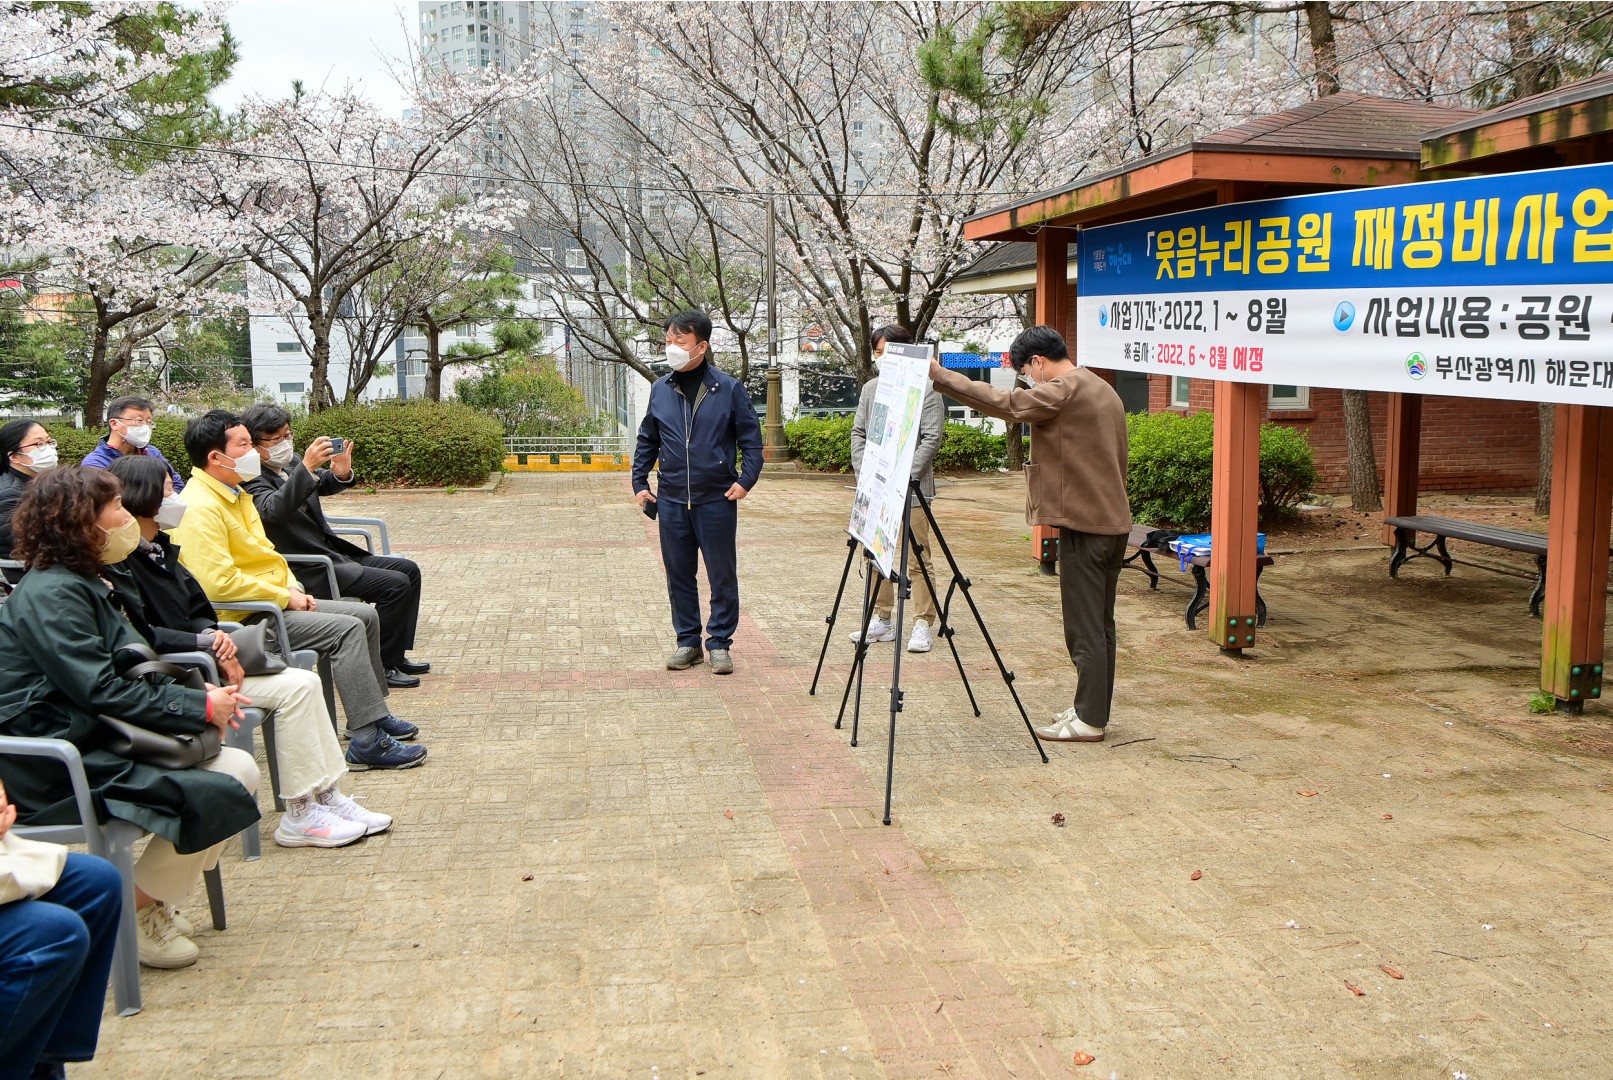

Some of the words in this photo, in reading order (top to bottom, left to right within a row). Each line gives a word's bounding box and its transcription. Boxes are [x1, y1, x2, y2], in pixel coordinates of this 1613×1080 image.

[1247, 297, 1287, 335] 8월
[1209, 345, 1228, 371] 8월
[1232, 346, 1264, 373] 예정
[1435, 355, 1536, 385] 부산광역시
[1545, 358, 1613, 389] 해운대
